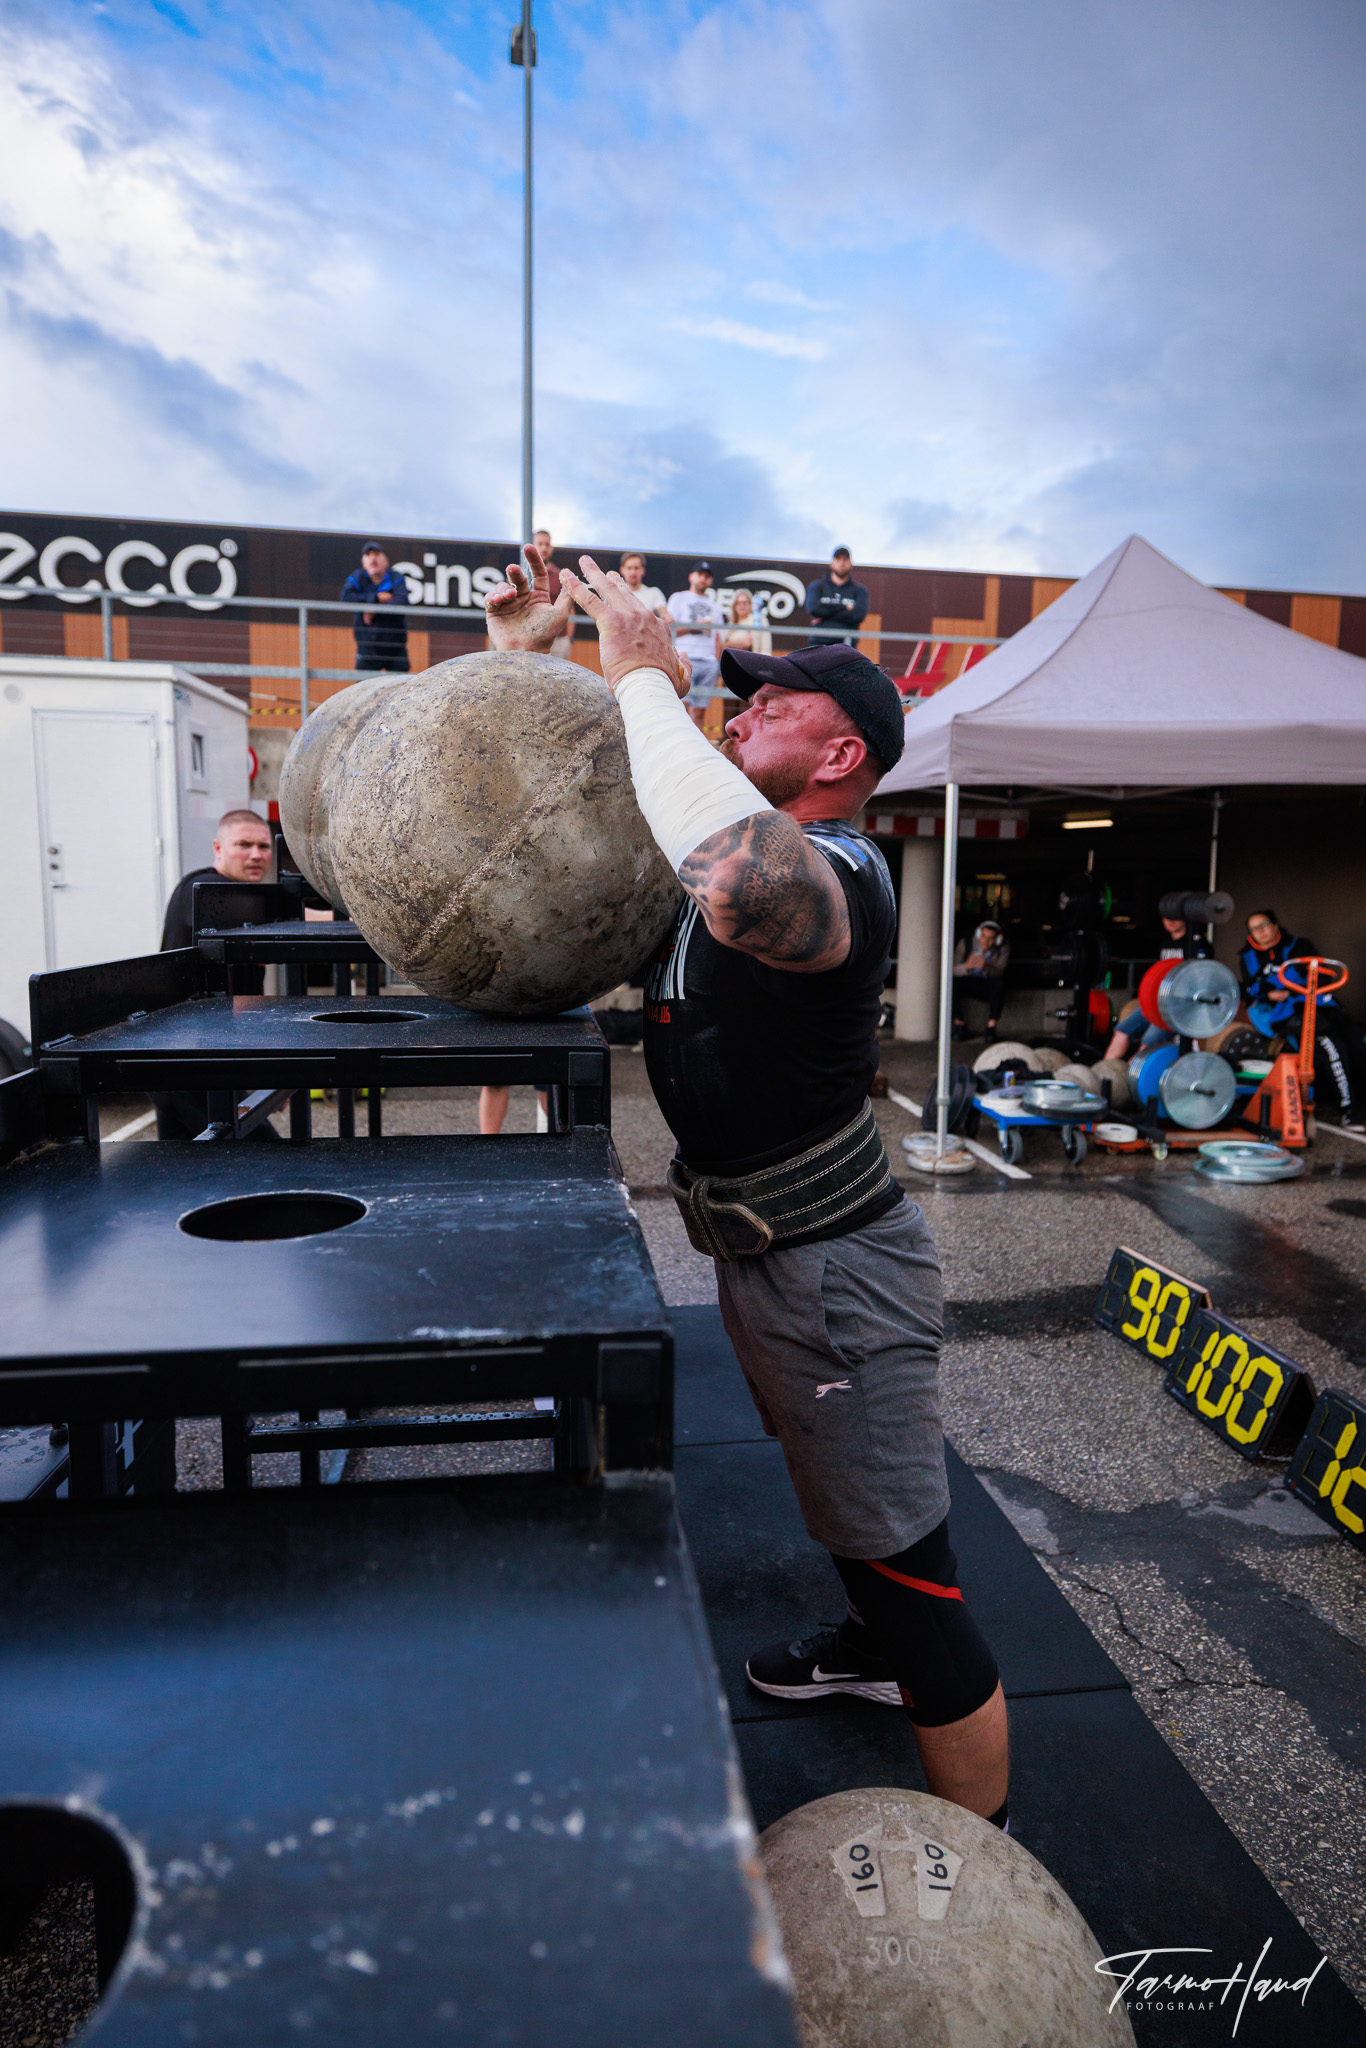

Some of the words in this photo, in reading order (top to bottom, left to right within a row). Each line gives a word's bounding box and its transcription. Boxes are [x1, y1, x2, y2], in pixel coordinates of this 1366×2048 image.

[0, 531, 238, 611] ecco
[392, 552, 505, 608] sins
[1121, 1266, 1191, 1359] 90
[1186, 1331, 1284, 1444] 100
[850, 1844, 878, 1892] 160
[924, 1843, 952, 1891] 160
